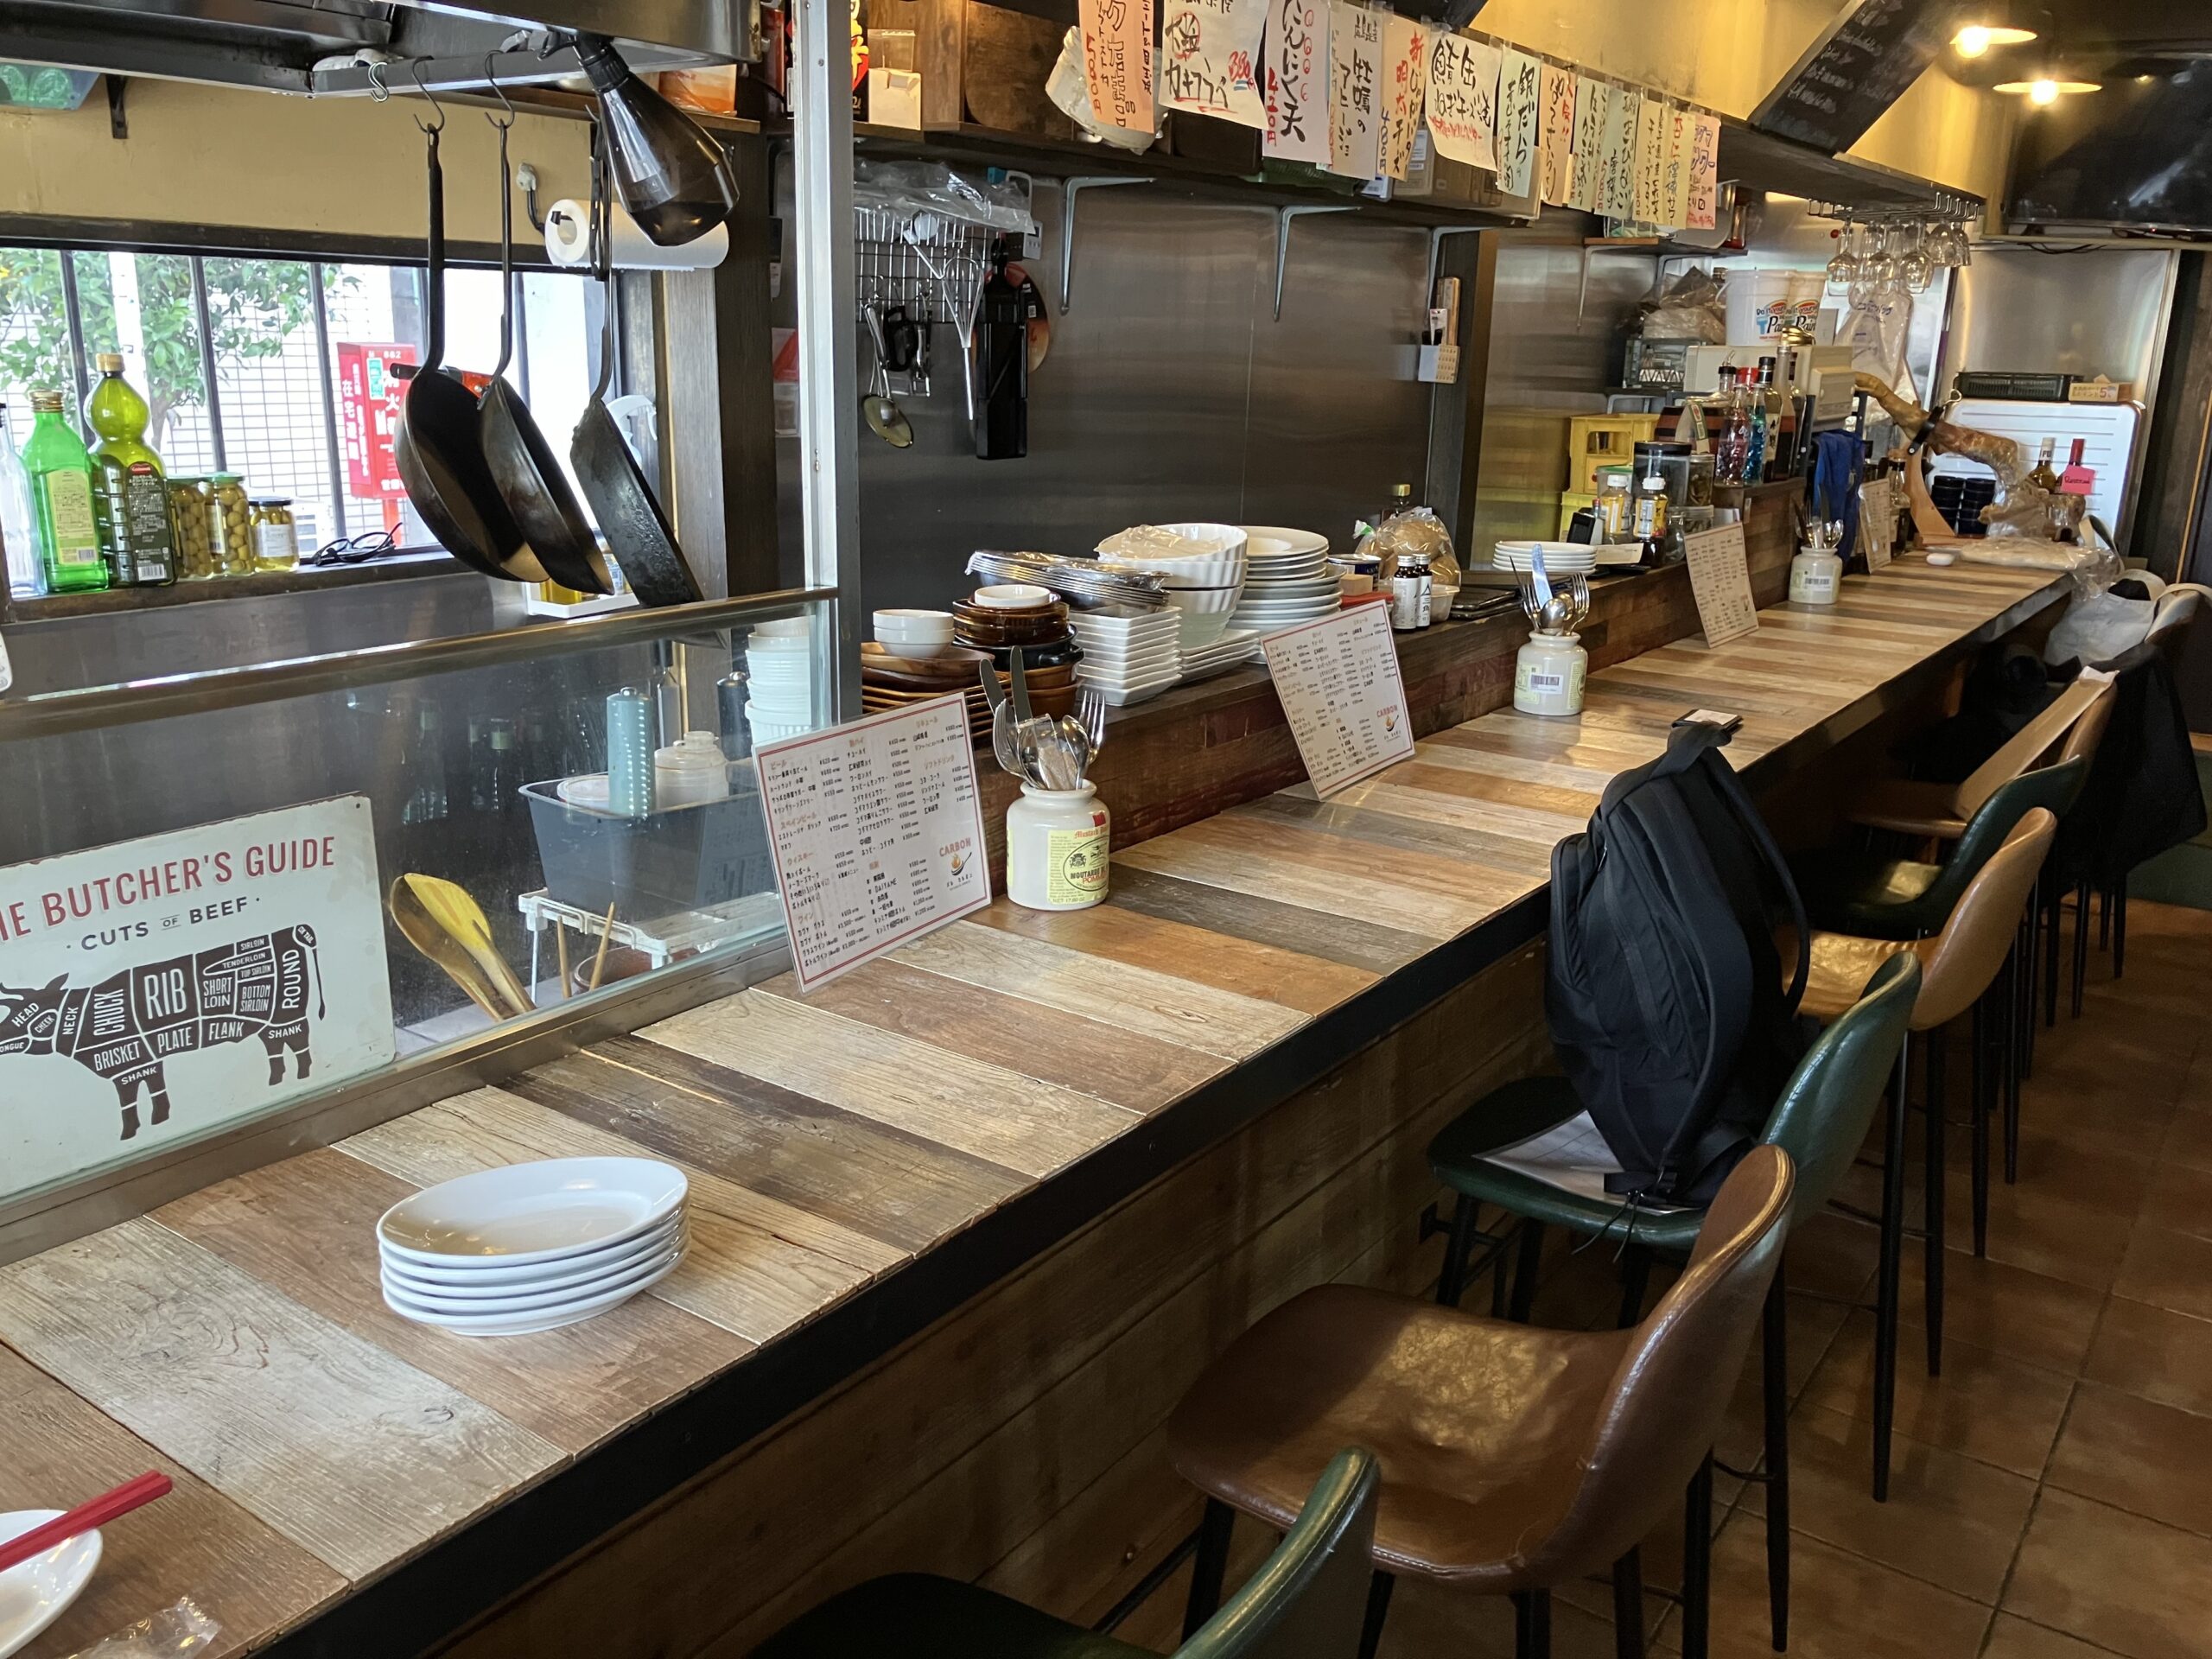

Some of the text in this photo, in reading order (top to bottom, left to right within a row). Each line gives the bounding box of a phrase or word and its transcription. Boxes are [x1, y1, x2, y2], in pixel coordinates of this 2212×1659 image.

[1431, 38, 1477, 90] 鯖缶
[1165, 58, 1229, 109] カキフライ
[1267, 67, 1279, 147] 420円
[1796, 315, 1816, 331] Pain
[939, 837, 972, 857] CARBON
[41, 851, 233, 926] BUTCHER'S
[245, 836, 335, 876] GUIDE
[81, 896, 248, 950] CUTS OF BEEF
[240, 938, 265, 951] SIRLOIN
[222, 952, 266, 969] TENDERLOIN
[203, 977, 232, 996] SHORT
[282, 950, 302, 1009] ROUND
[144, 968, 187, 1020] RIB
[204, 995, 231, 1009] LOIN
[242, 985, 271, 1000] BOTTOM
[11, 1002, 40, 1027] HEAD
[93, 988, 124, 1036] CHUCK
[240, 999, 269, 1012] SIRLOIN
[35, 1015, 54, 1033] CHEEK
[62, 1007, 79, 1035] NECK
[209, 1021, 245, 1040] FLANK
[268, 1024, 302, 1039] SHANK
[0, 1042, 24, 1052] ONGUE
[157, 1027, 193, 1053] PLATE
[93, 1041, 140, 1071] BRISKET
[121, 1065, 157, 1086] SHANK
